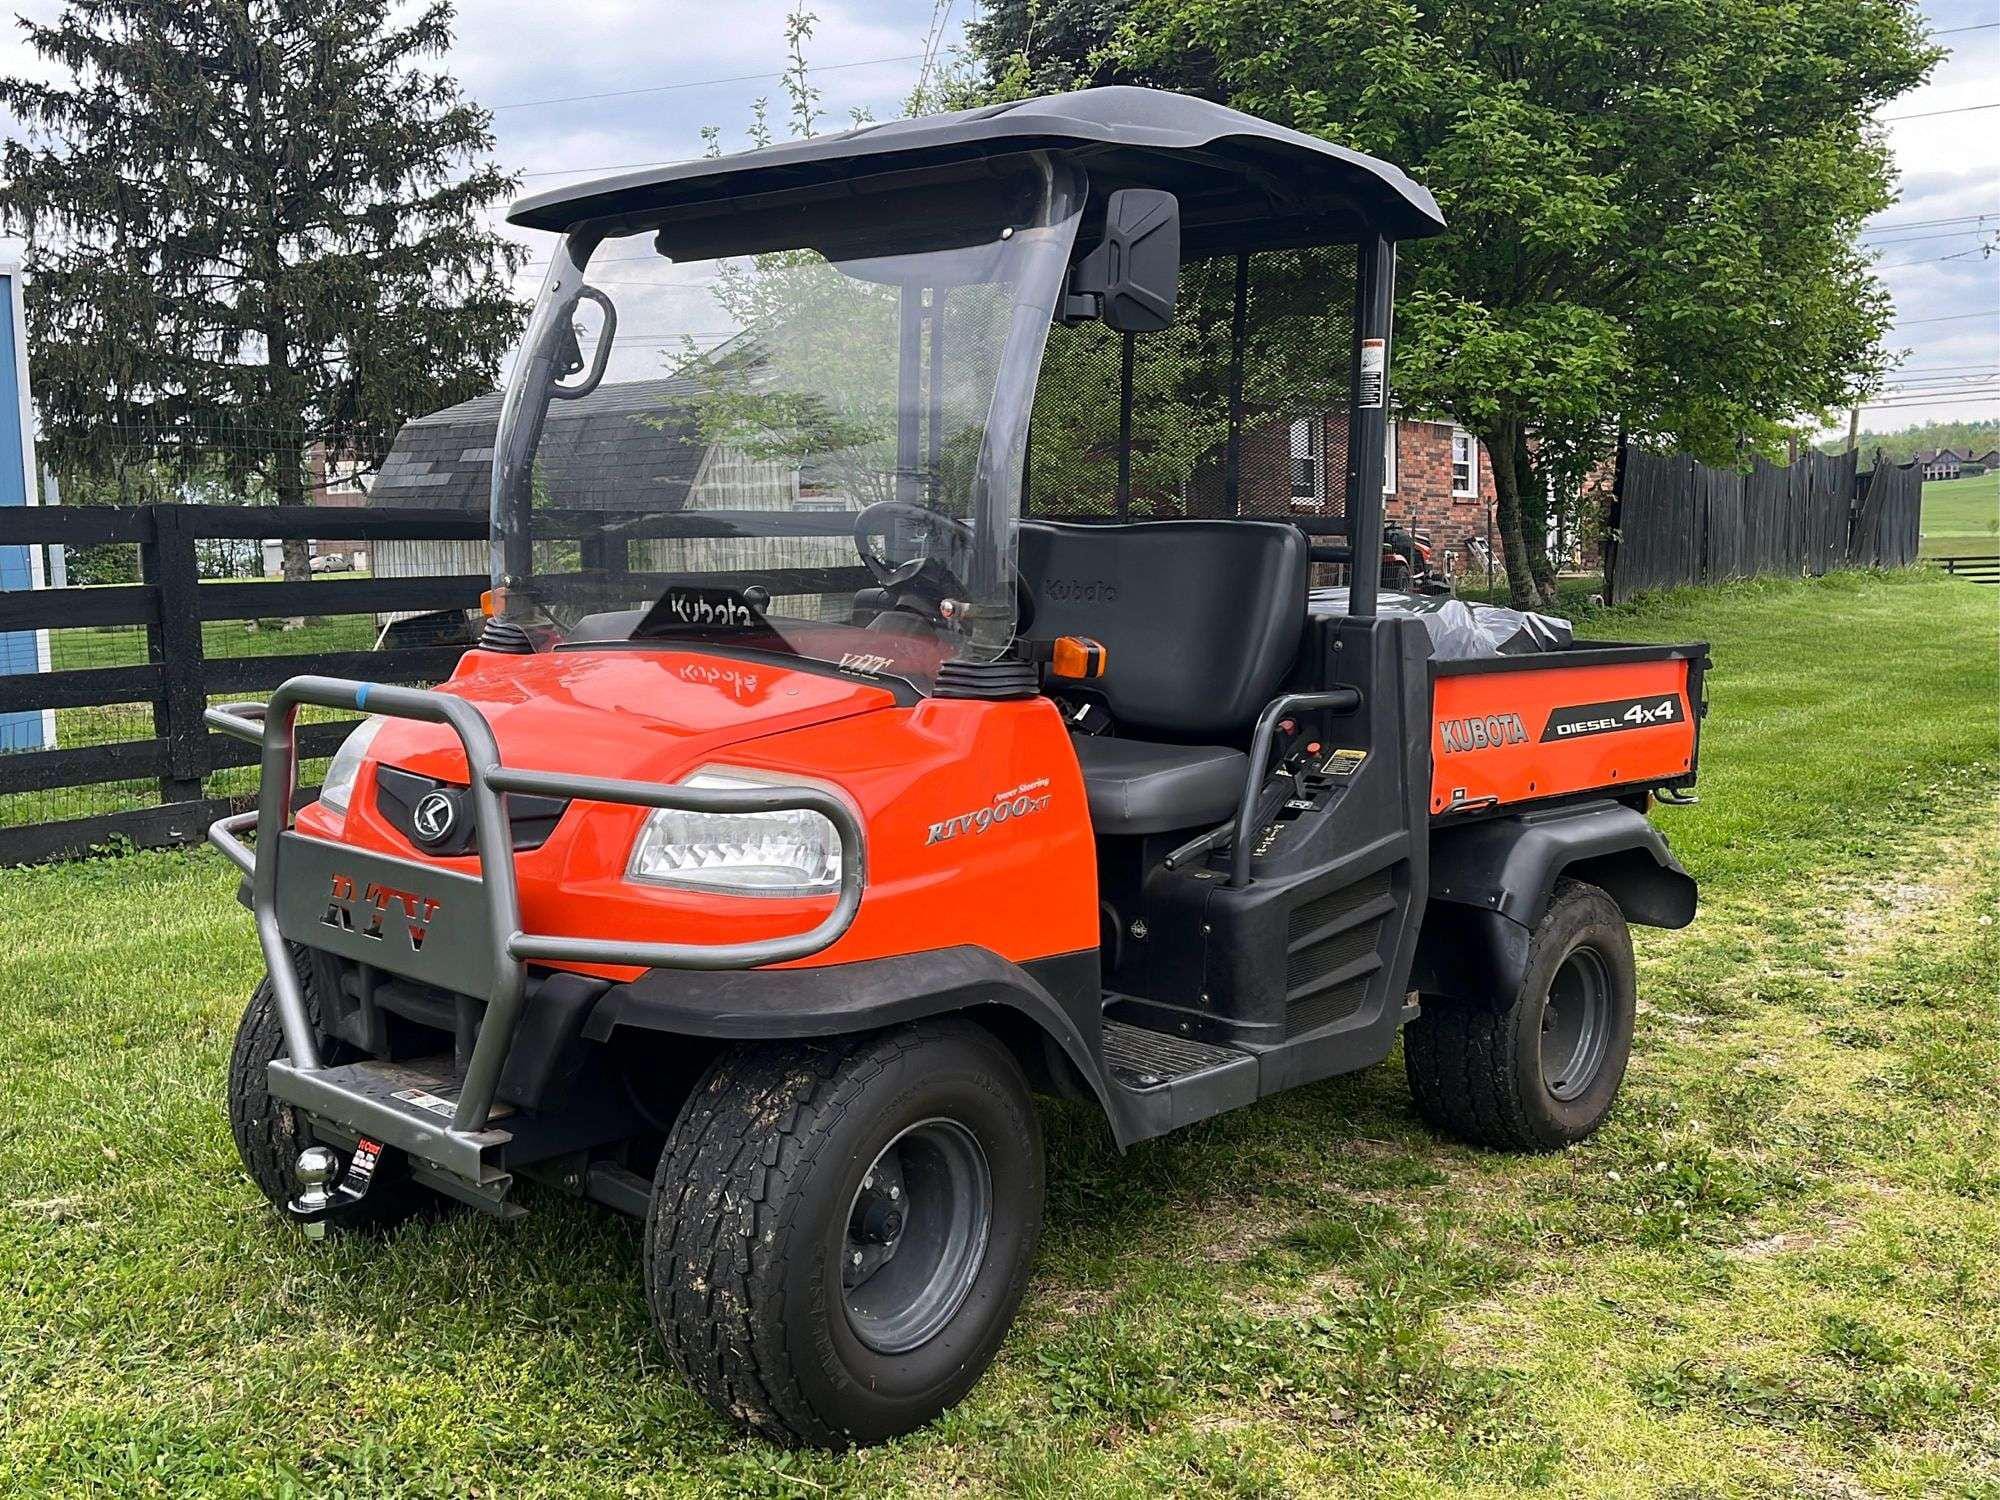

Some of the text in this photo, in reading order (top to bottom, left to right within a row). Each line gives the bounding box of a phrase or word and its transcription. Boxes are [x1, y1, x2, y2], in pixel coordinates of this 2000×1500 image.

[1046, 577, 1120, 601] Kubota
[670, 593, 753, 626] Kubota
[1439, 712, 1529, 753] KUBOTA
[1556, 700, 1675, 736] DIESEL 4x4
[319, 871, 441, 952] RTV
